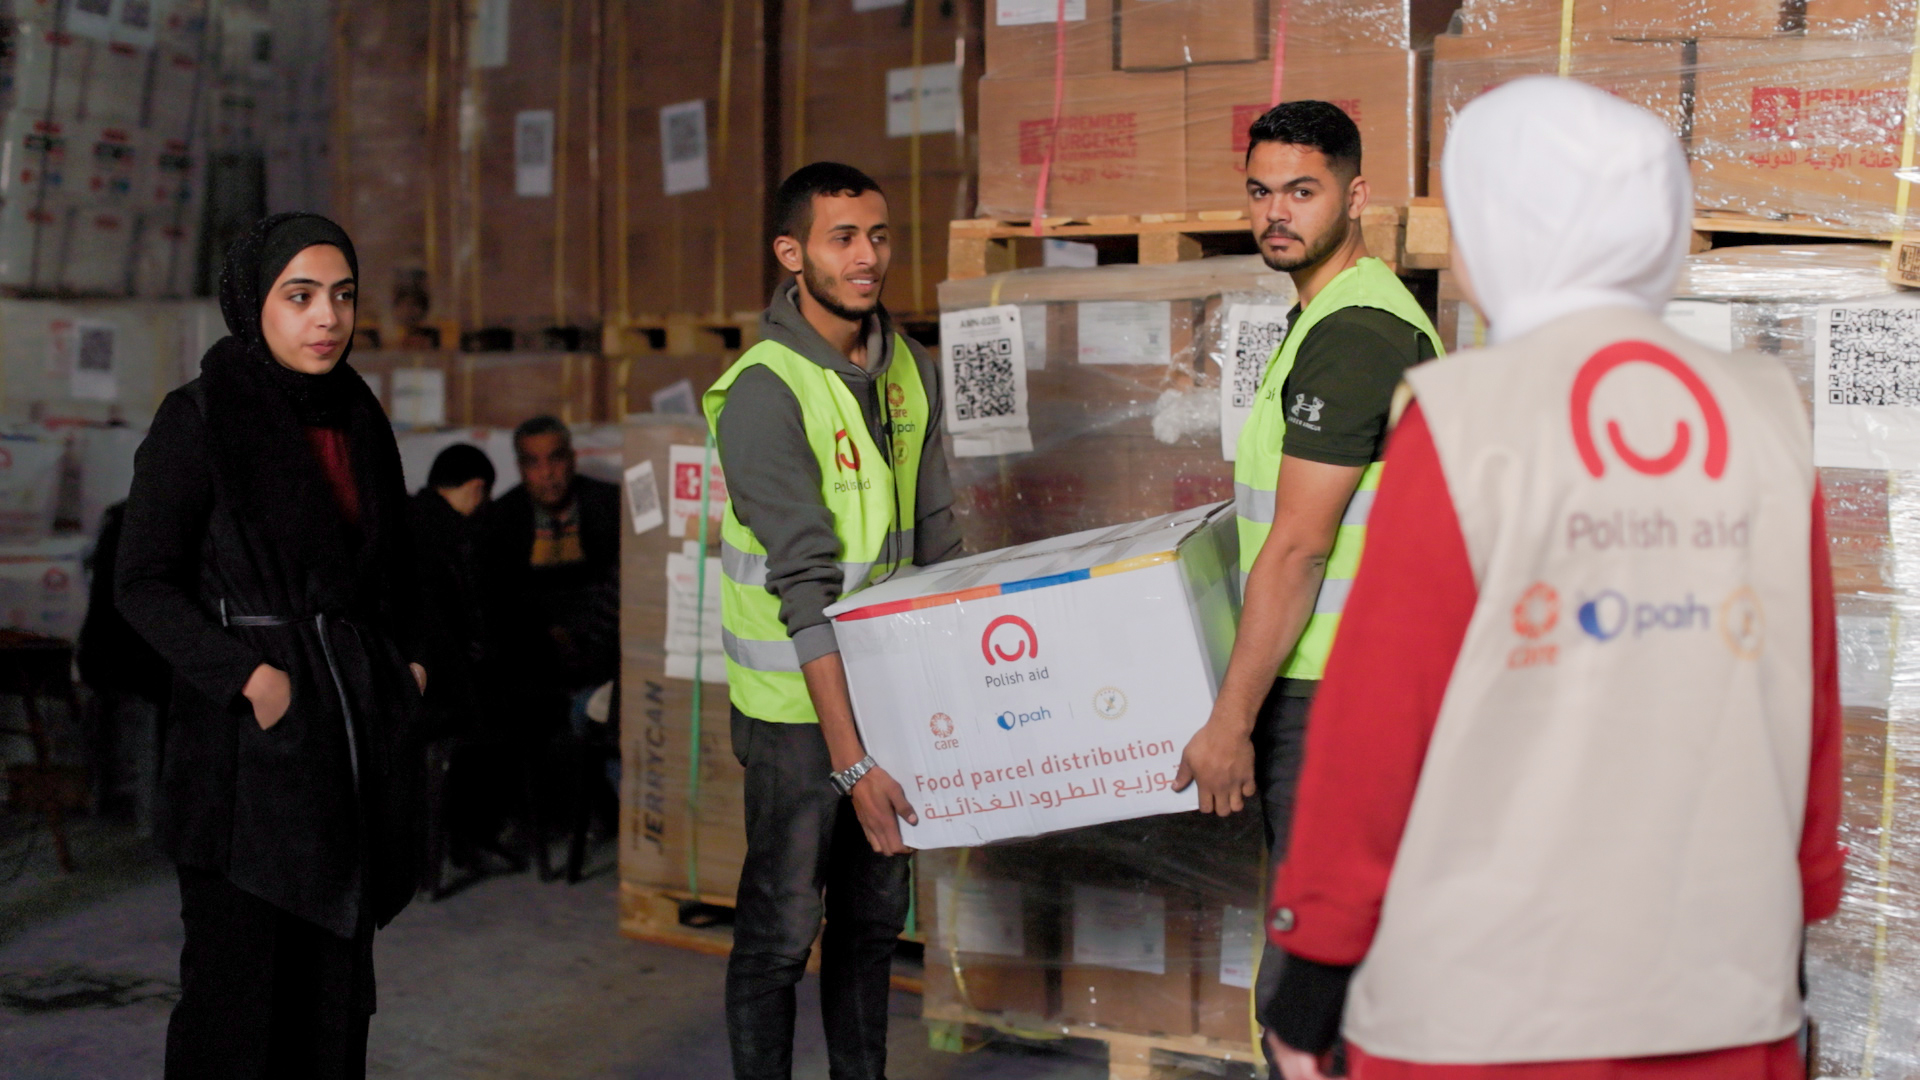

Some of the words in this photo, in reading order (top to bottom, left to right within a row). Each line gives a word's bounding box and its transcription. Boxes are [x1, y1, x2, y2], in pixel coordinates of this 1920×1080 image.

[1567, 509, 1678, 550] Polish
[1692, 511, 1749, 550] aid
[1633, 592, 1711, 638] pah
[984, 671, 1024, 688] Polish
[1028, 666, 1050, 682] aid
[1018, 706, 1052, 728] pah
[934, 737, 960, 751] care
[914, 769, 965, 793] Food
[970, 759, 1035, 794] parcel
[1040, 739, 1175, 775] distribution
[923, 790, 1024, 823] الغذائية
[1029, 777, 1108, 809] الطرود
